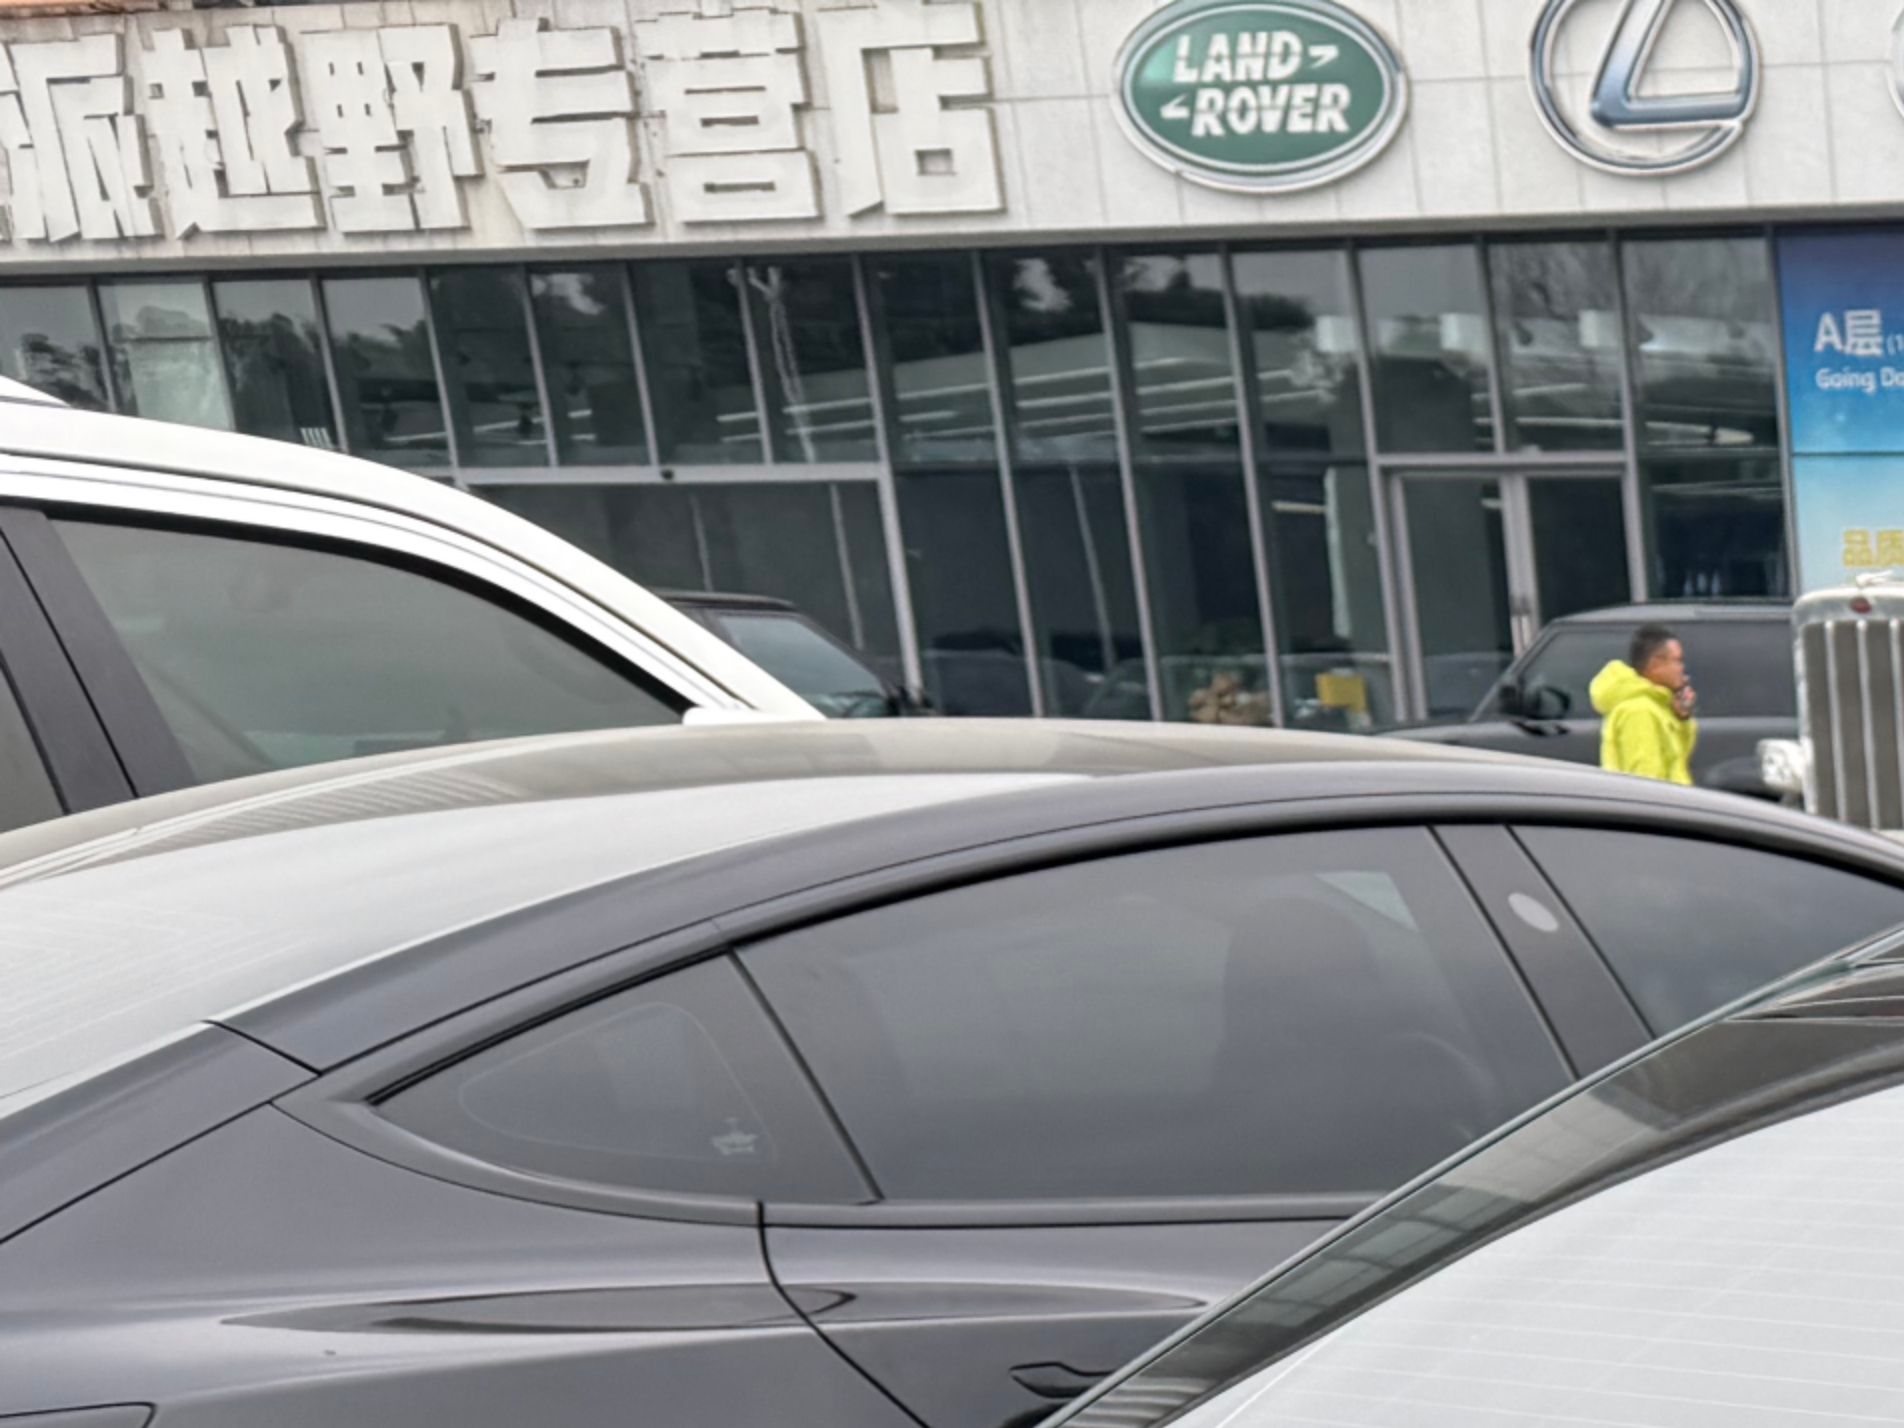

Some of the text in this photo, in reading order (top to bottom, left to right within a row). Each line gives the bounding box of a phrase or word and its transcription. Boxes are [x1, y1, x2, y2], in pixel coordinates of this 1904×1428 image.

[1172, 30, 1300, 82] LAND
[1190, 82, 1351, 138] ROVER
[1816, 367, 1877, 394] Going
